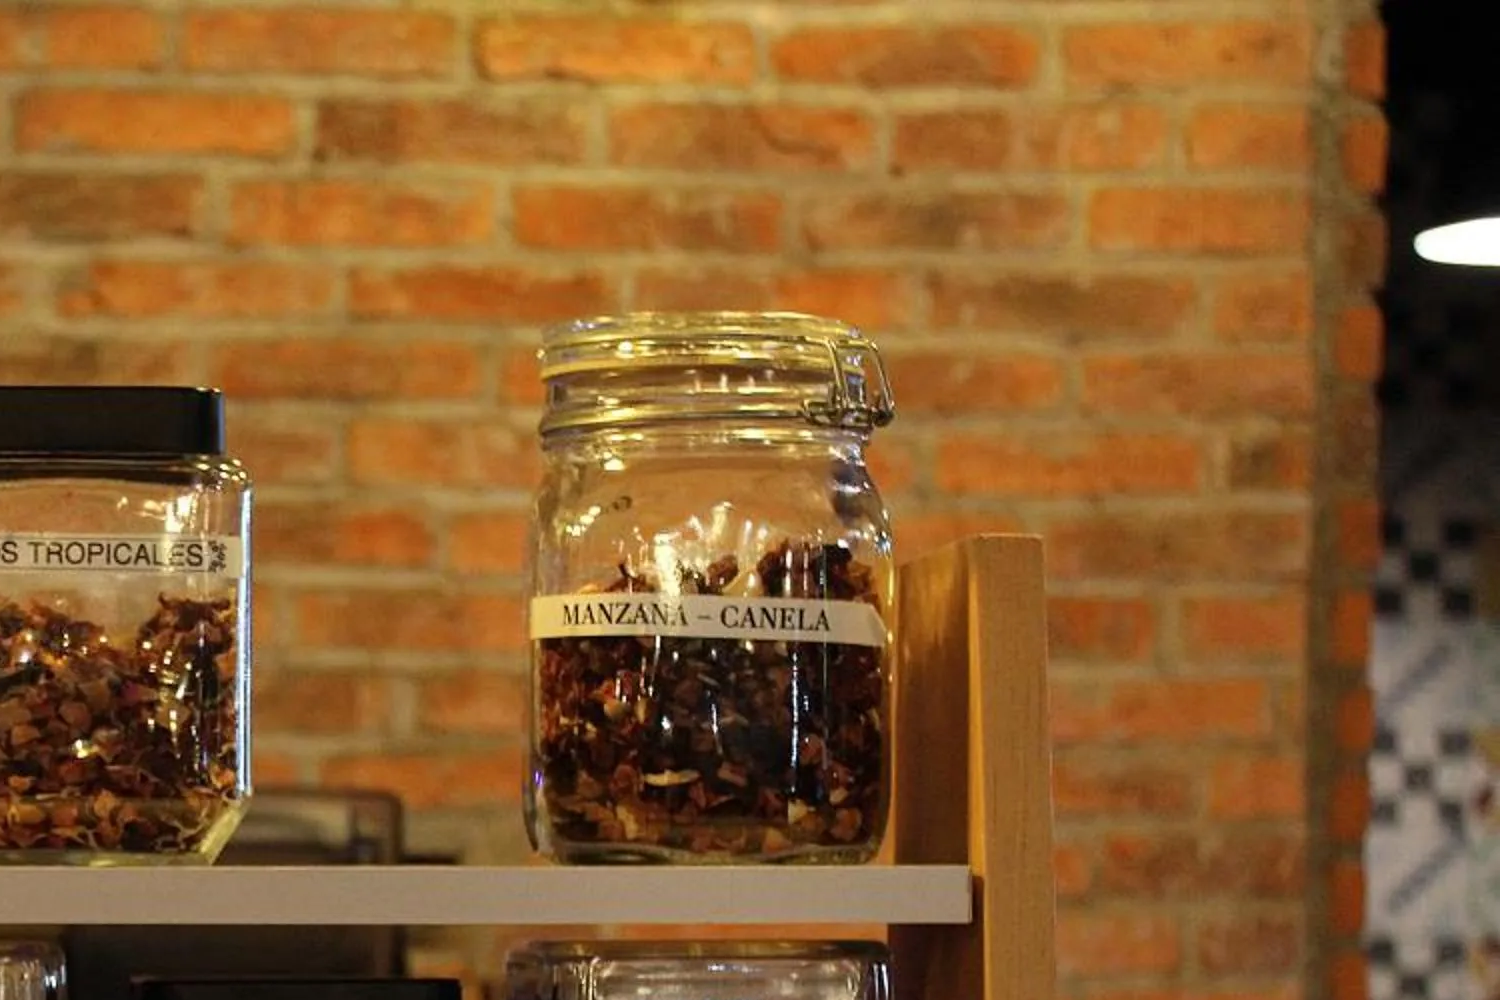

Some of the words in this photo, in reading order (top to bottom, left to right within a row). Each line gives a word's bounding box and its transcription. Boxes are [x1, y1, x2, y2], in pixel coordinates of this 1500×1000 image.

[30, 541, 203, 567] TROPICALES
[562, 602, 689, 627] MANZANA
[720, 604, 831, 632] CANELA
